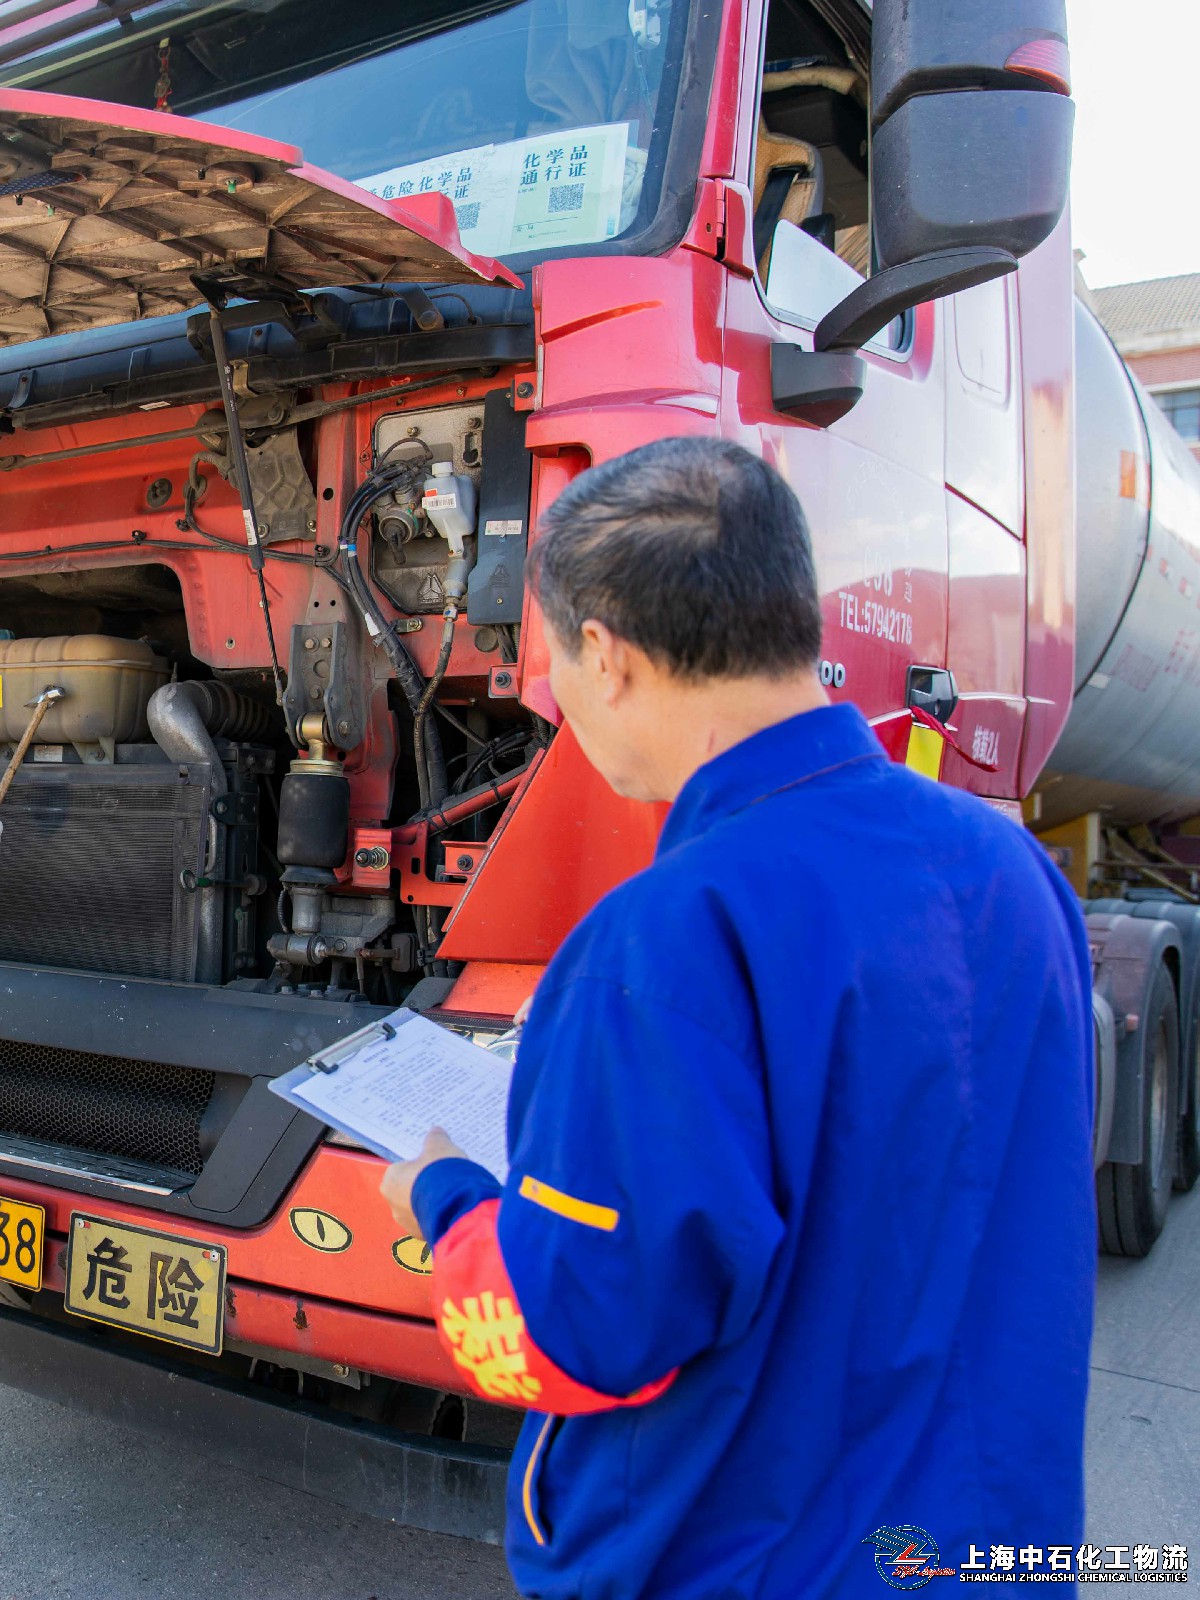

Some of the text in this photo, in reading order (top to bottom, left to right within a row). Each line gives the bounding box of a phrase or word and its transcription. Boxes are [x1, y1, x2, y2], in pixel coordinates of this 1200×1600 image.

[524, 145, 588, 169] 化学品
[520, 161, 587, 186] 通行证
[83, 1237, 205, 1329] 危险
